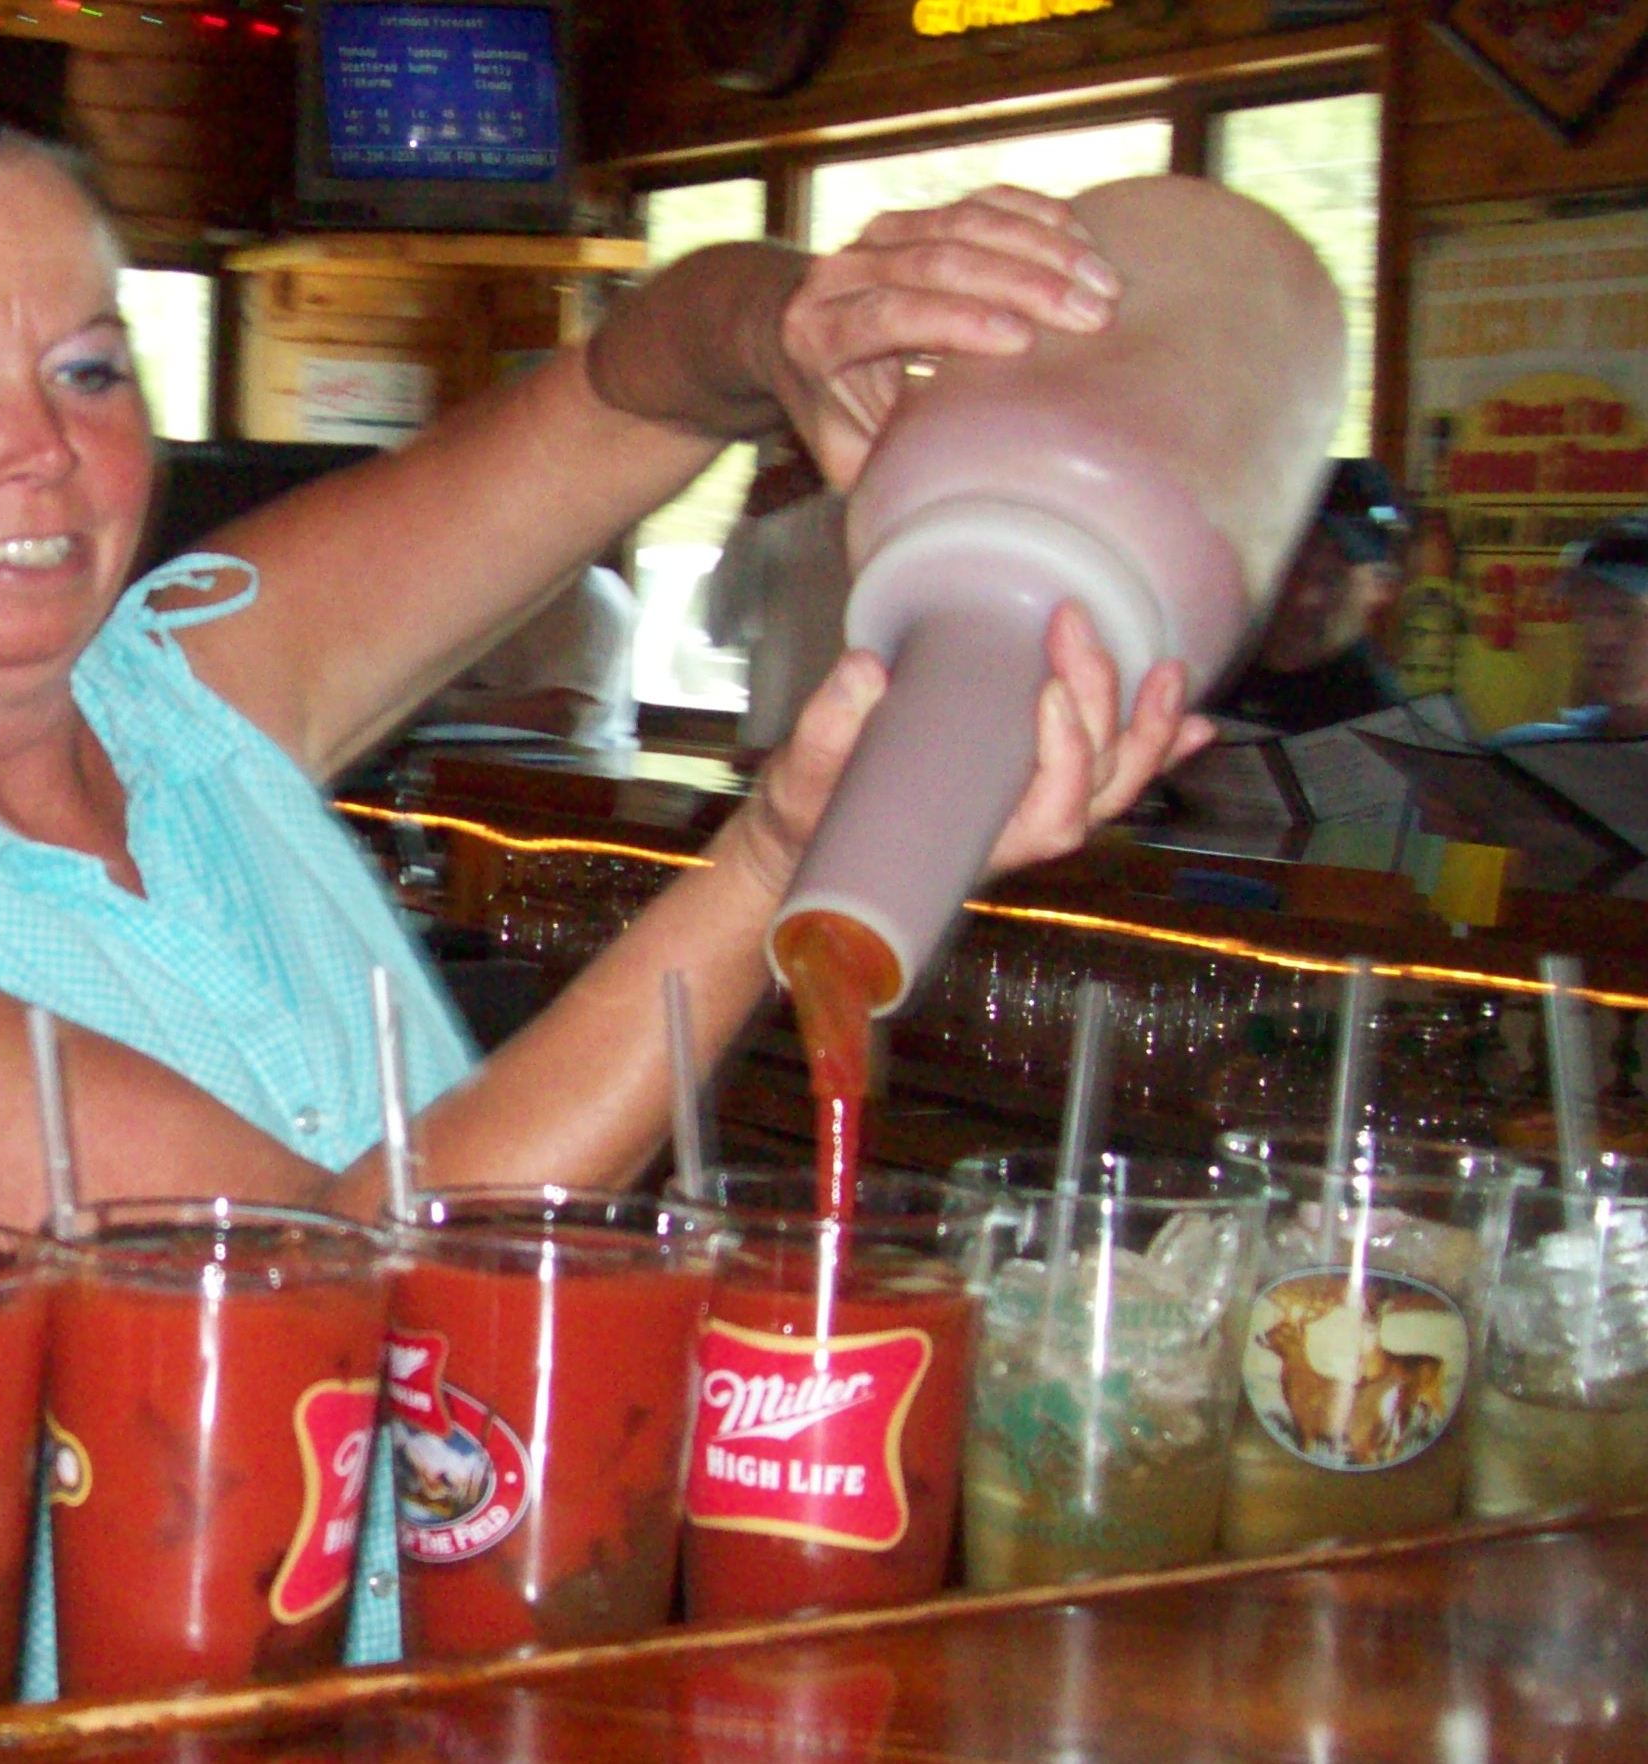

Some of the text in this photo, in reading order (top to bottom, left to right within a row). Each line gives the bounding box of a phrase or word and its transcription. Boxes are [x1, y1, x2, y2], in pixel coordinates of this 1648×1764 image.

[702, 1368, 876, 1438] Miller
[705, 1444, 867, 1497] HIGH LIFE
[452, 1504, 511, 1551] FIELD
